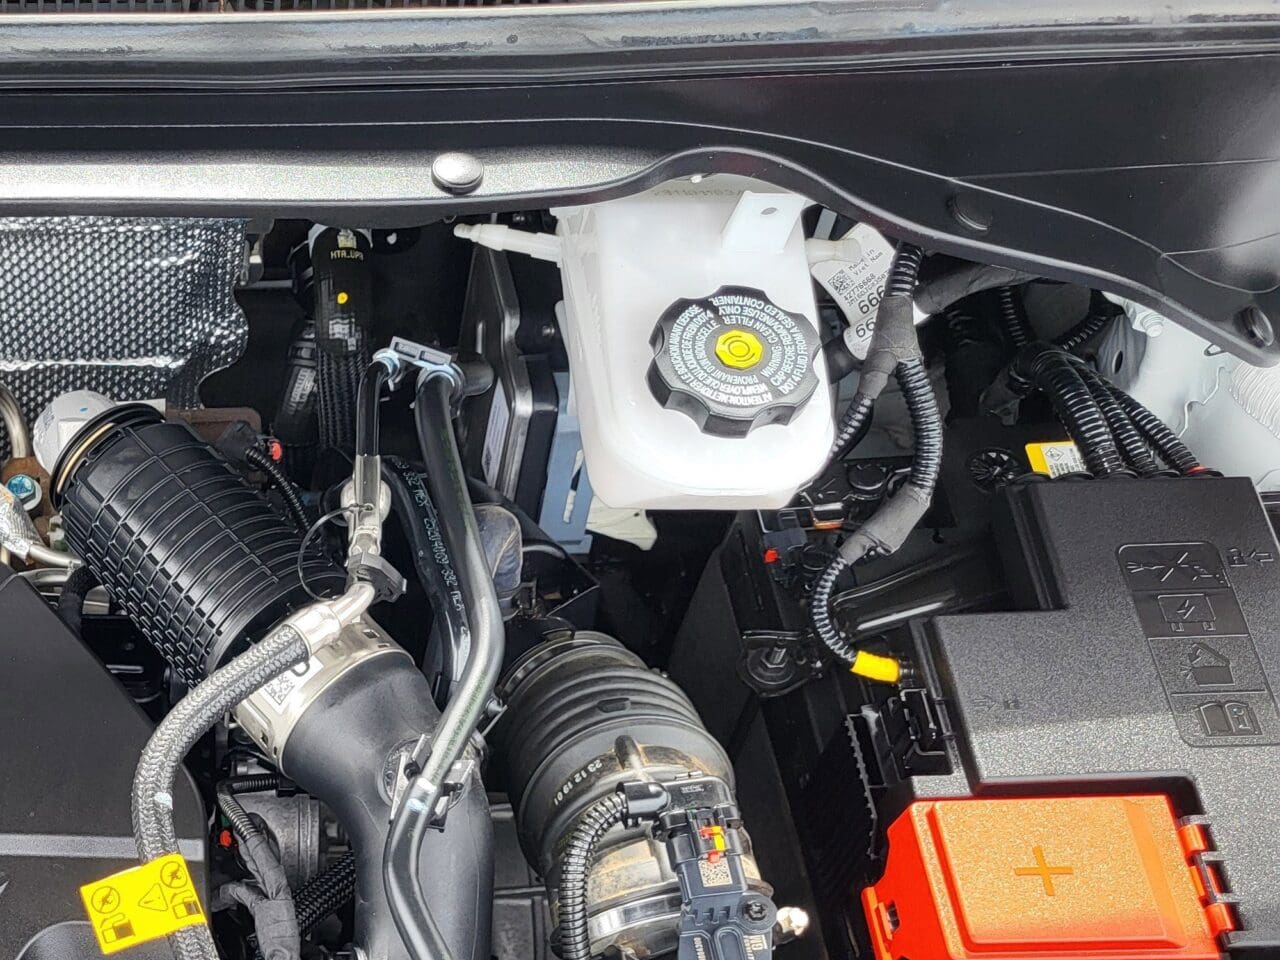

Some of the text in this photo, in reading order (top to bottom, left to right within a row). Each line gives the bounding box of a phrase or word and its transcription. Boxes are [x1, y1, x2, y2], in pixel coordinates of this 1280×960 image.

[692, 312, 710, 326] DOT
[715, 306, 741, 317] ONLY
[742, 307, 761, 318] USE
[763, 304, 796, 329] SEALED
[722, 316, 755, 327] FILLER
[753, 321, 779, 344] CLEAN
[793, 333, 807, 355] FROM
[781, 345, 795, 374] BEFORE
[793, 356, 808, 378] FLUID
[769, 370, 788, 387] CAP
[778, 378, 797, 395] DOT
[587, 760, 603, 772] 23
[574, 770, 587, 783] 12
